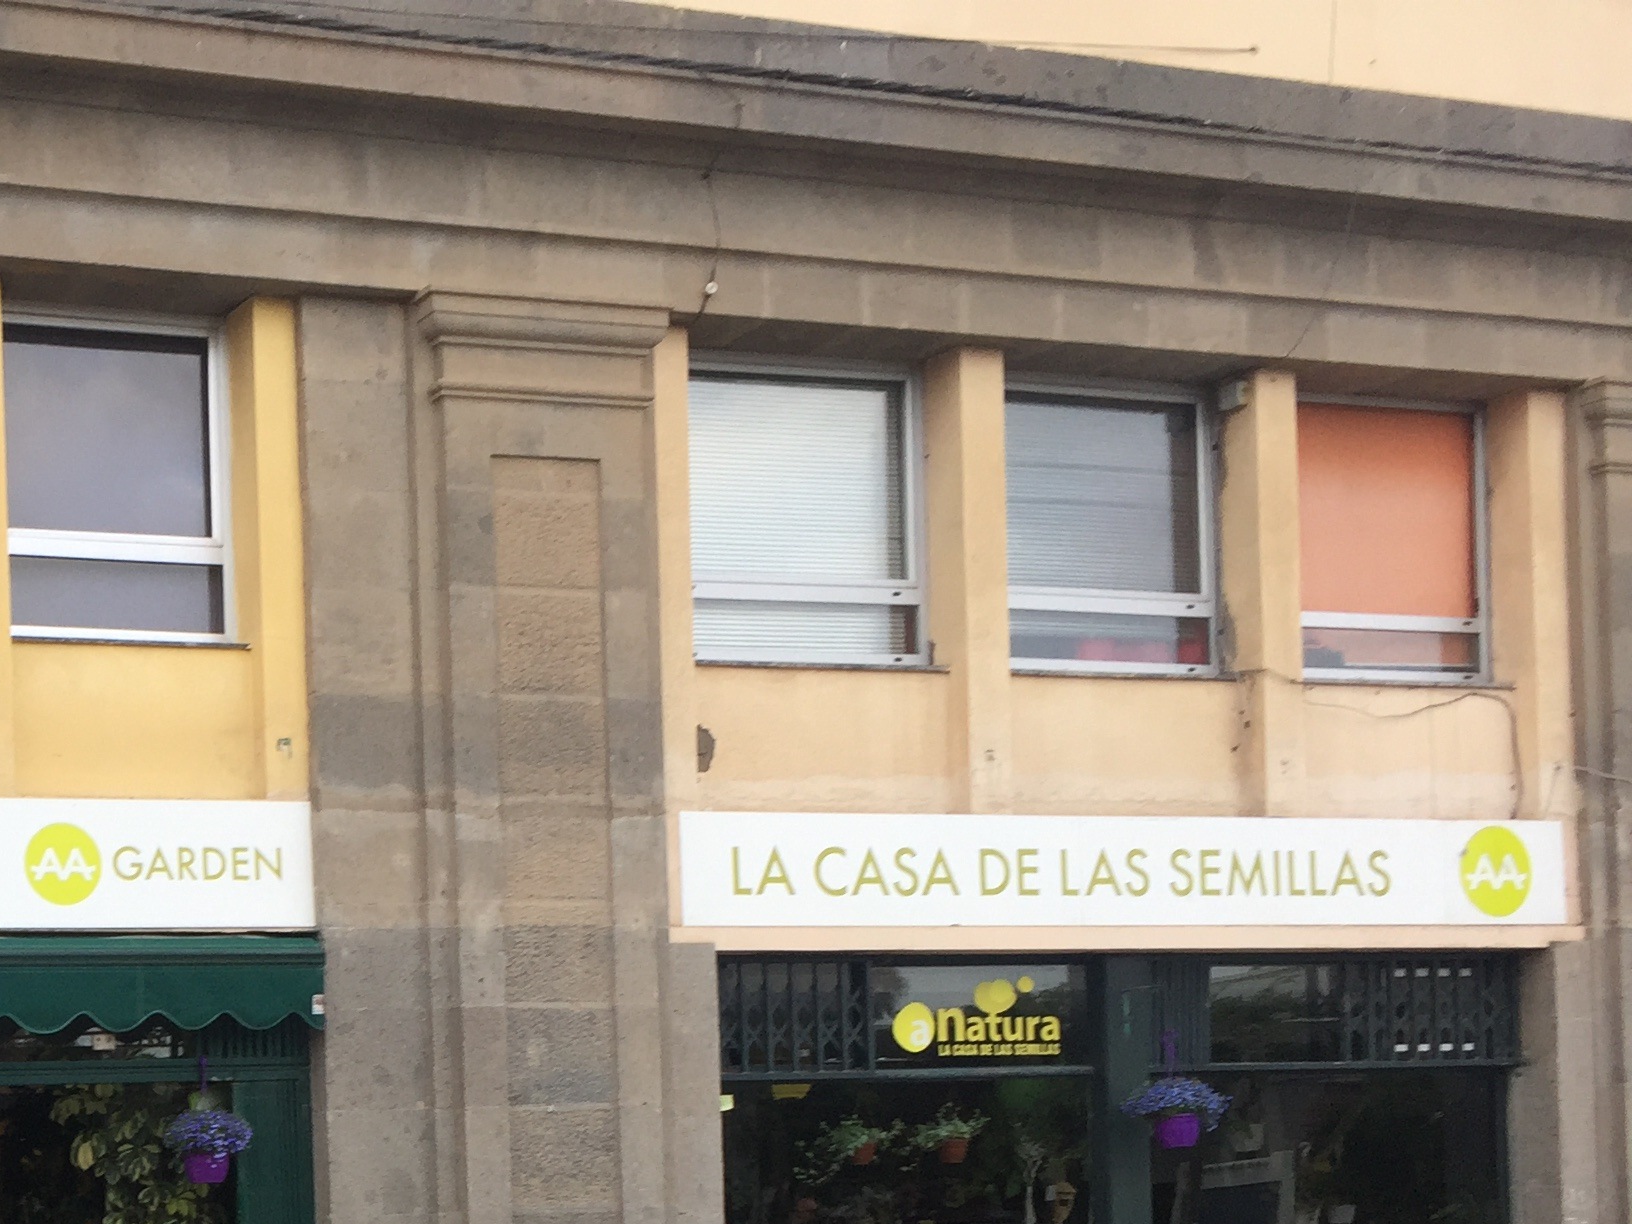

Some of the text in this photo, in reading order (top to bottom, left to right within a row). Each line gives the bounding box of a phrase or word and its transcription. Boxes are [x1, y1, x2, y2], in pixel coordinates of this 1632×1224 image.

[112, 846, 283, 881] GARDEN
[731, 846, 1393, 897] LA CASA DE LAS SEMILLAS
